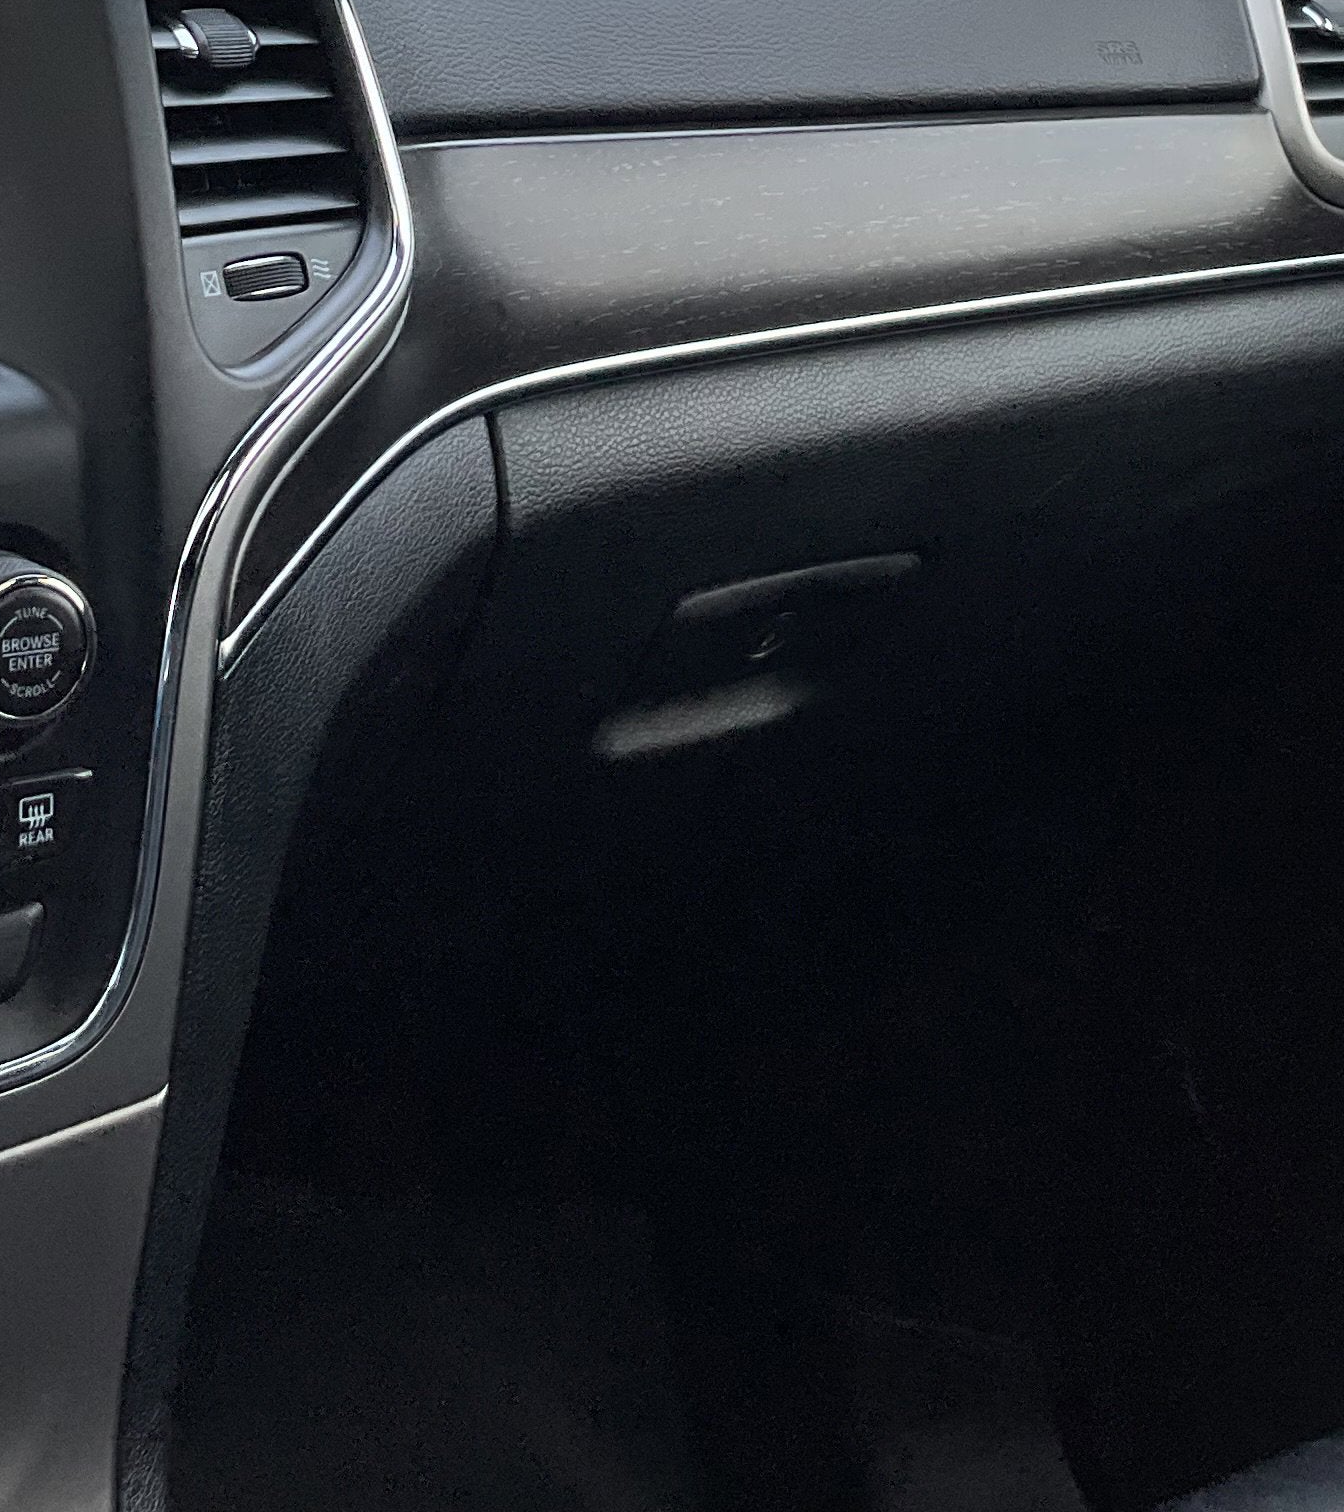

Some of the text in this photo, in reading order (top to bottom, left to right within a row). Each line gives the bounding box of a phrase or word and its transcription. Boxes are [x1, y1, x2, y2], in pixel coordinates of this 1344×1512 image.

[14, 606, 49, 621] TUNE
[2, 632, 60, 653] BROWSE
[8, 653, 53, 673] ENTER
[9, 678, 56, 698] SCROLL
[18, 827, 54, 848] REAR
